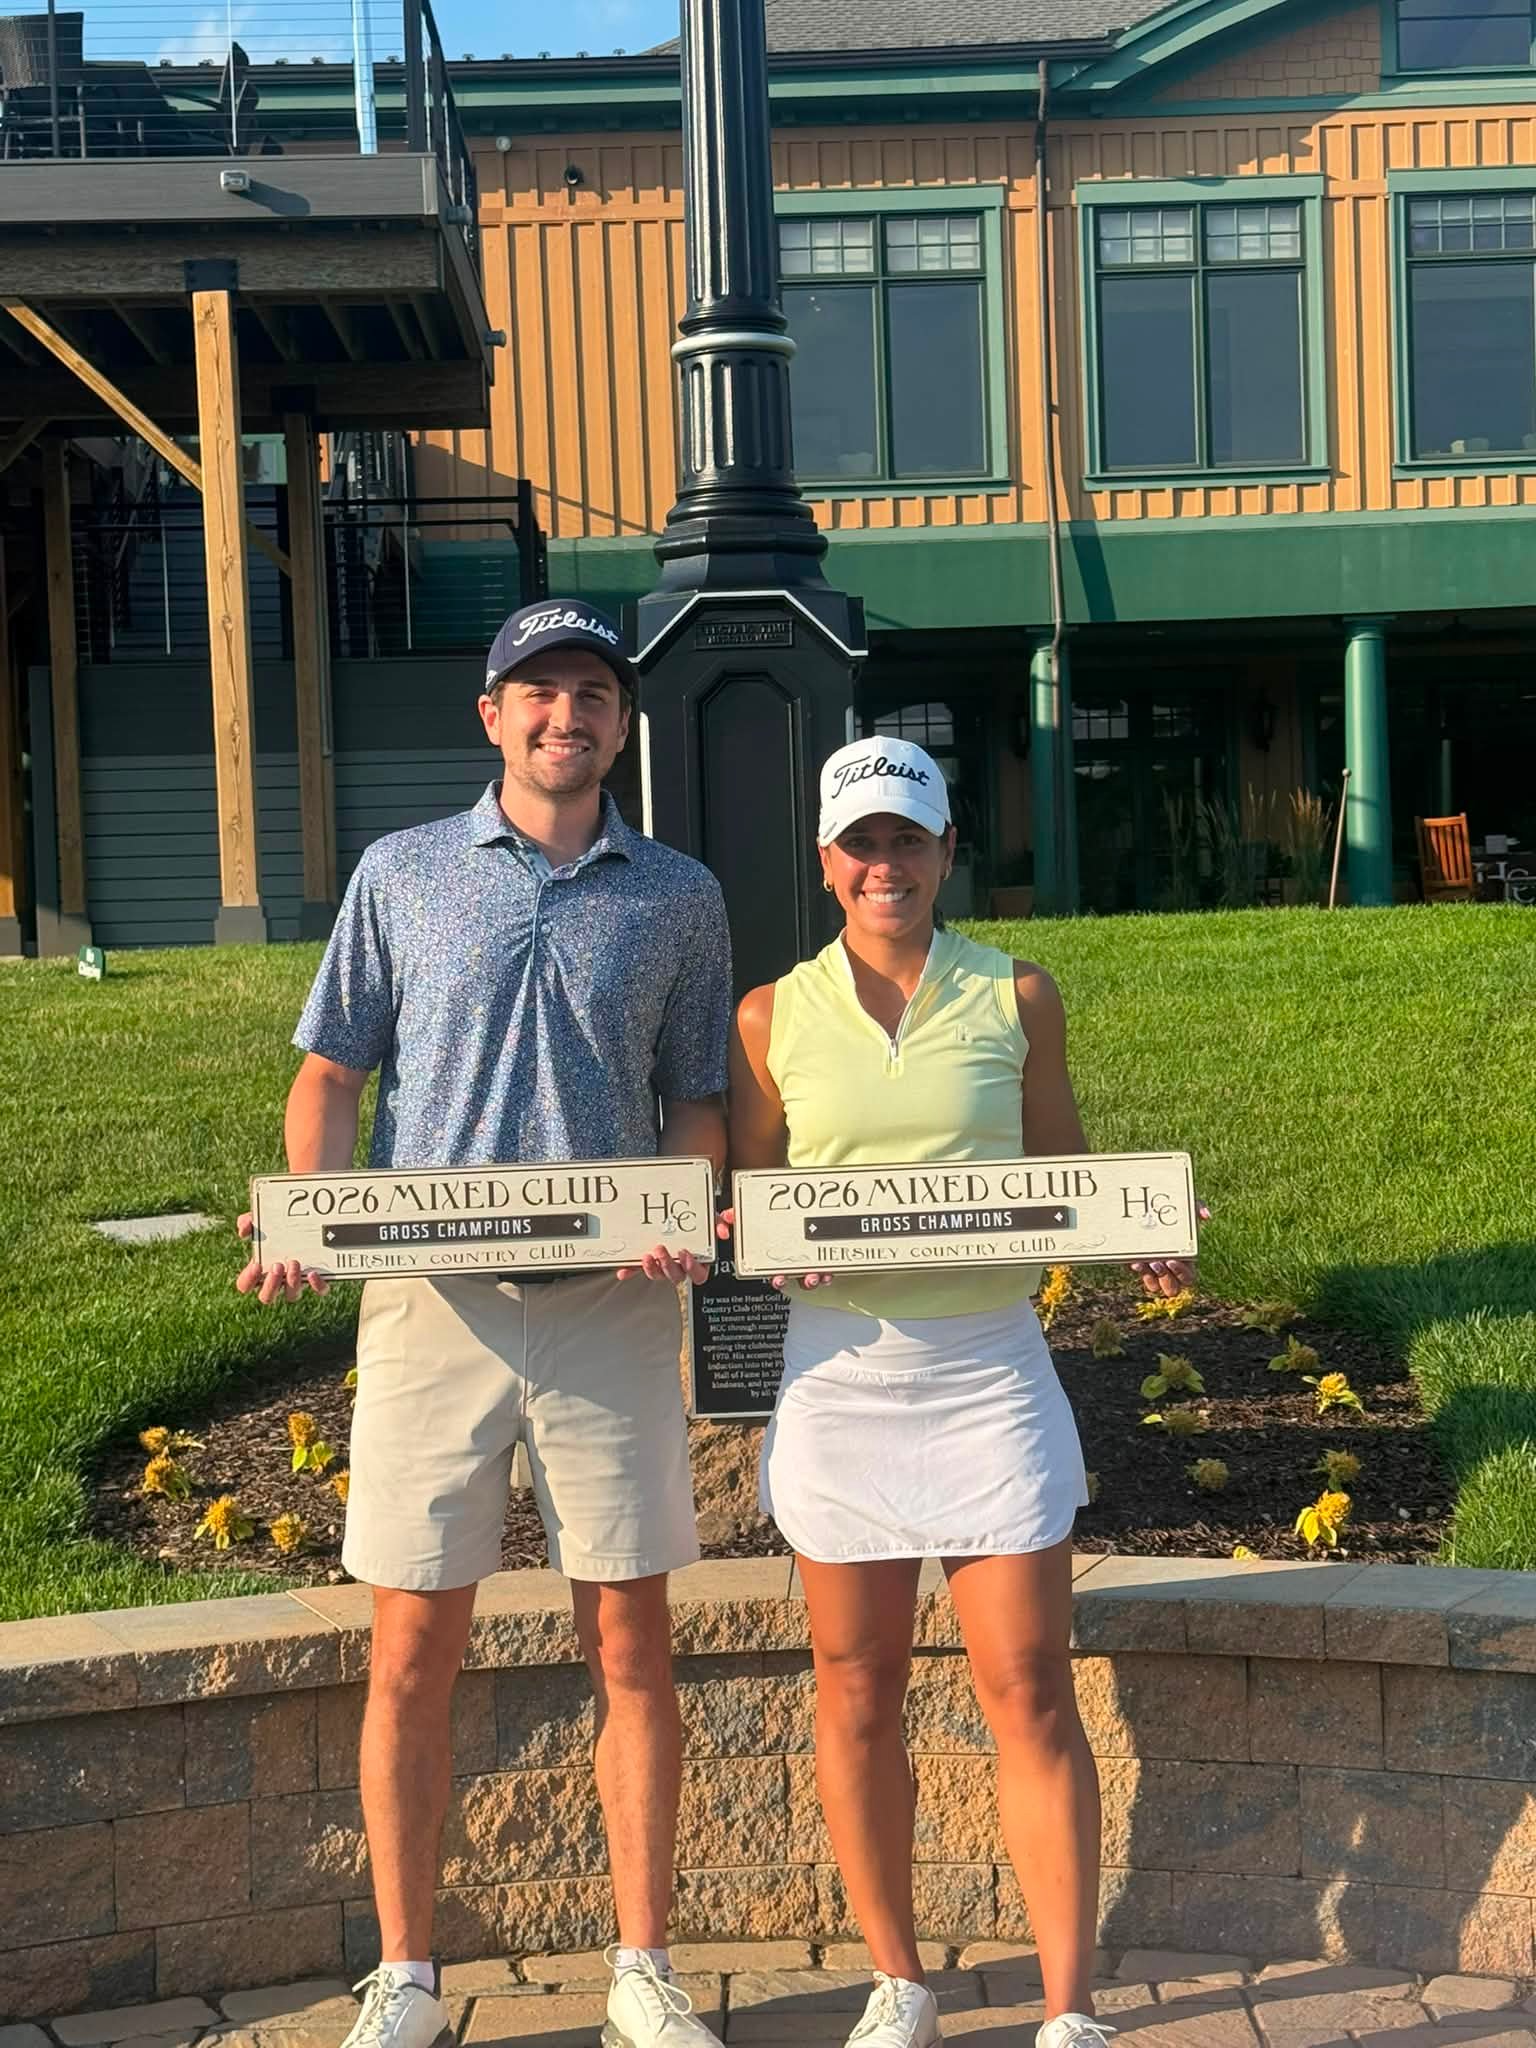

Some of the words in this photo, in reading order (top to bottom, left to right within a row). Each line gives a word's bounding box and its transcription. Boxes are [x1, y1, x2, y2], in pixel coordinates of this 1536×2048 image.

[512, 607, 619, 646] Titleist
[831, 755, 930, 799] Titleist
[288, 1186, 380, 1216] 2026
[386, 1179, 510, 1212] MIXED
[521, 1175, 619, 1206] CLUB
[769, 1180, 860, 1210] 2026
[866, 1174, 989, 1206] MIXED
[1001, 1169, 1098, 1200] CLUB
[378, 1223, 430, 1241] GROSS
[437, 1218, 532, 1238] CHAMPIONS
[860, 1216, 911, 1233] GROSS
[918, 1210, 1013, 1231] CHAMPIONS
[336, 1253, 419, 1268] HERSHEY
[429, 1248, 517, 1265] COUNTRY
[528, 1243, 576, 1260] CLUB
[817, 1246, 899, 1261] HERSHEY
[910, 1242, 999, 1258] COUNTRY
[1009, 1236, 1056, 1253] CLUB
[702, 1305, 731, 1313] Country
[745, 1295, 764, 1303] Head
